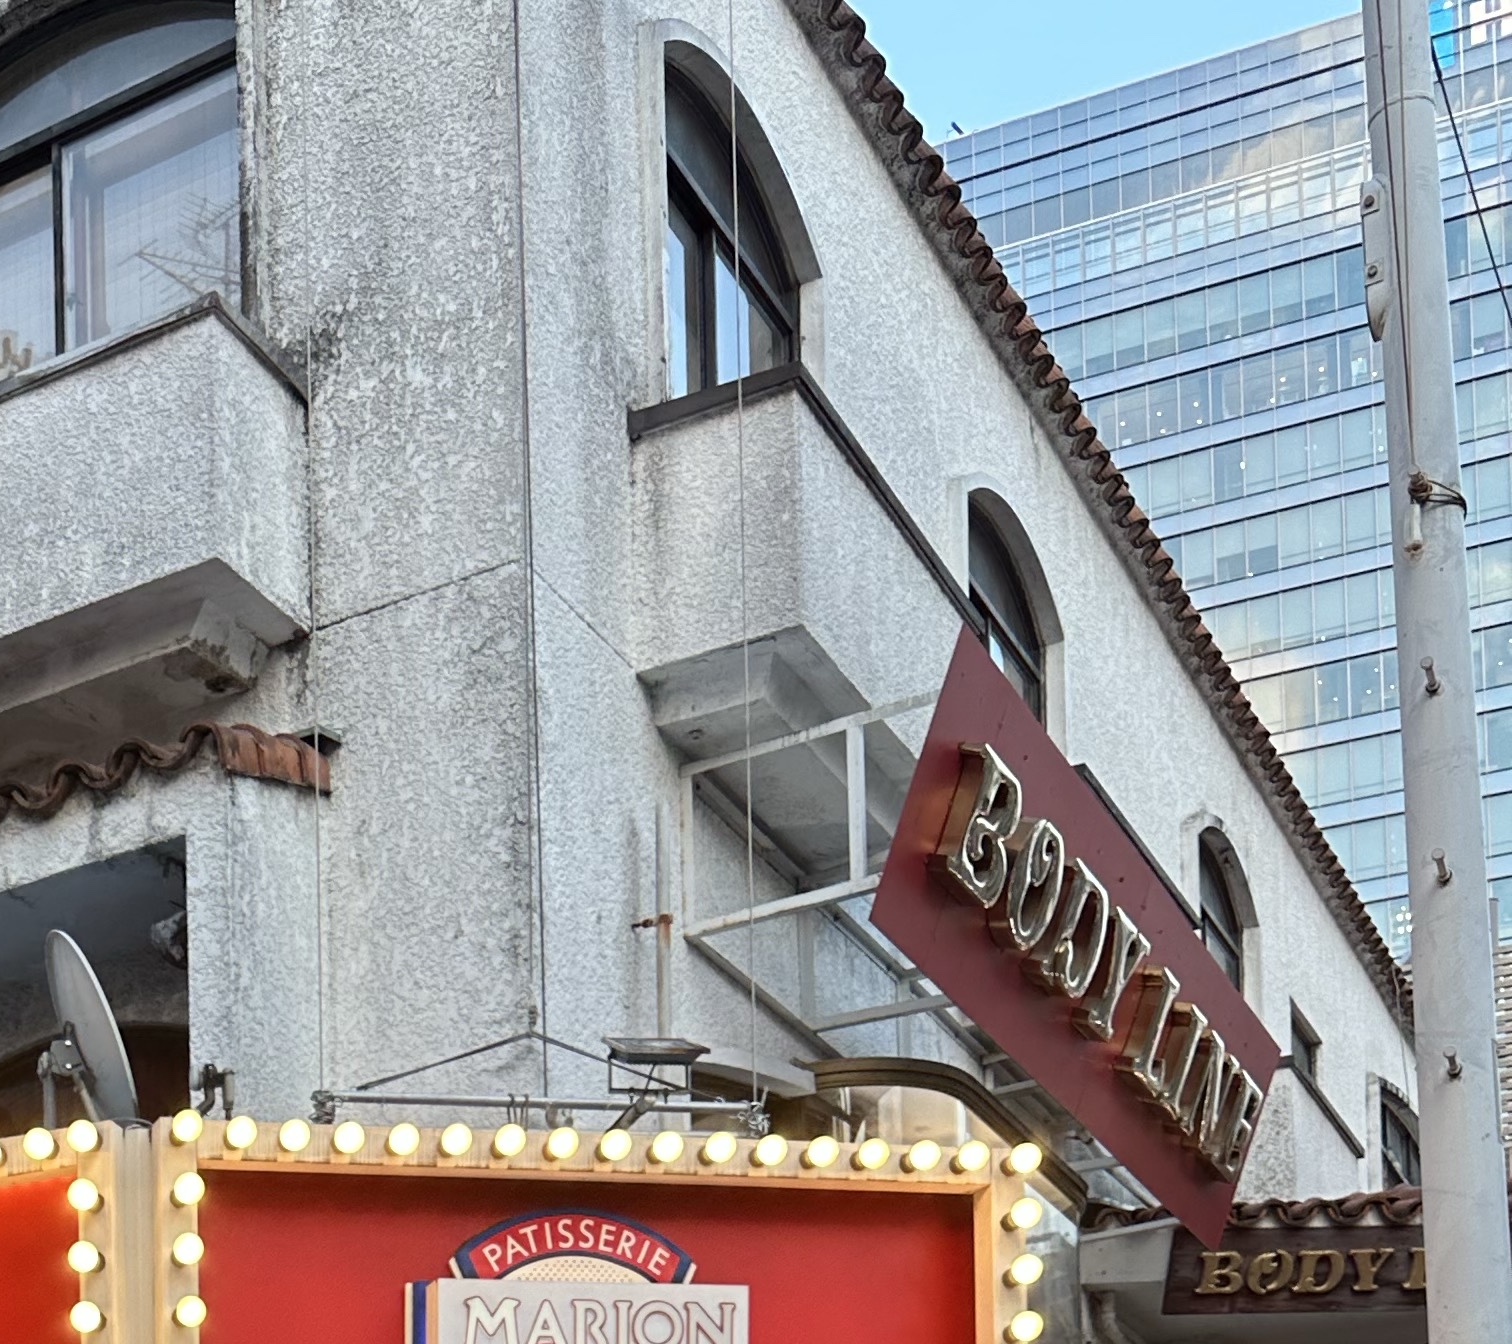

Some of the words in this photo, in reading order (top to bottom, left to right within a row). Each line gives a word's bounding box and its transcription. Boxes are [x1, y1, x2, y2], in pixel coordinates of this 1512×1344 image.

[927, 742, 1151, 1042] BODY
[1113, 965, 1264, 1184] LINE
[482, 1218, 671, 1276] PATISSERIE
[1194, 1248, 1394, 1294] BODY
